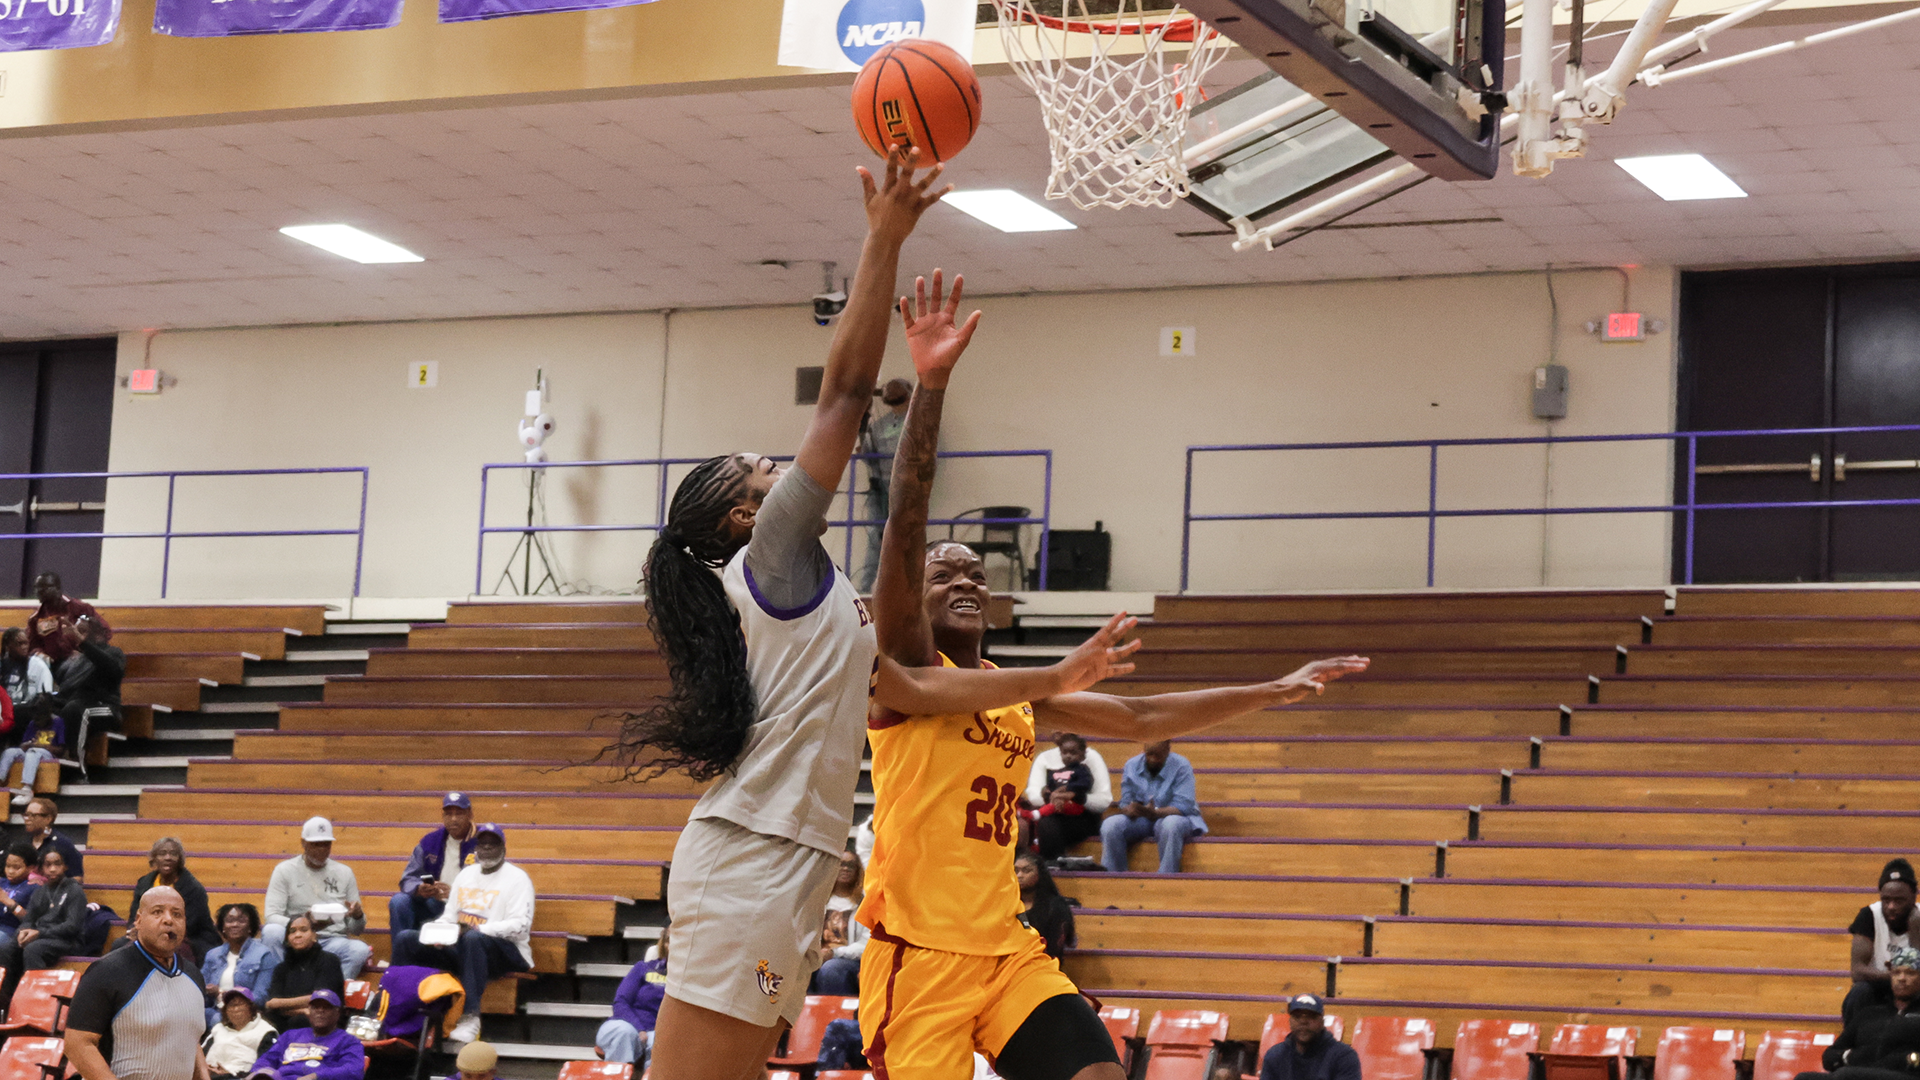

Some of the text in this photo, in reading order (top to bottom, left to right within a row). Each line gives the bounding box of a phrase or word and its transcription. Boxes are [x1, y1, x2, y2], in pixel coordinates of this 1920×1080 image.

[843, 21, 921, 47] NCAA
[1173, 336, 1181, 348] 2
[420, 370, 427, 381] 2
[964, 775, 1016, 847] 20
